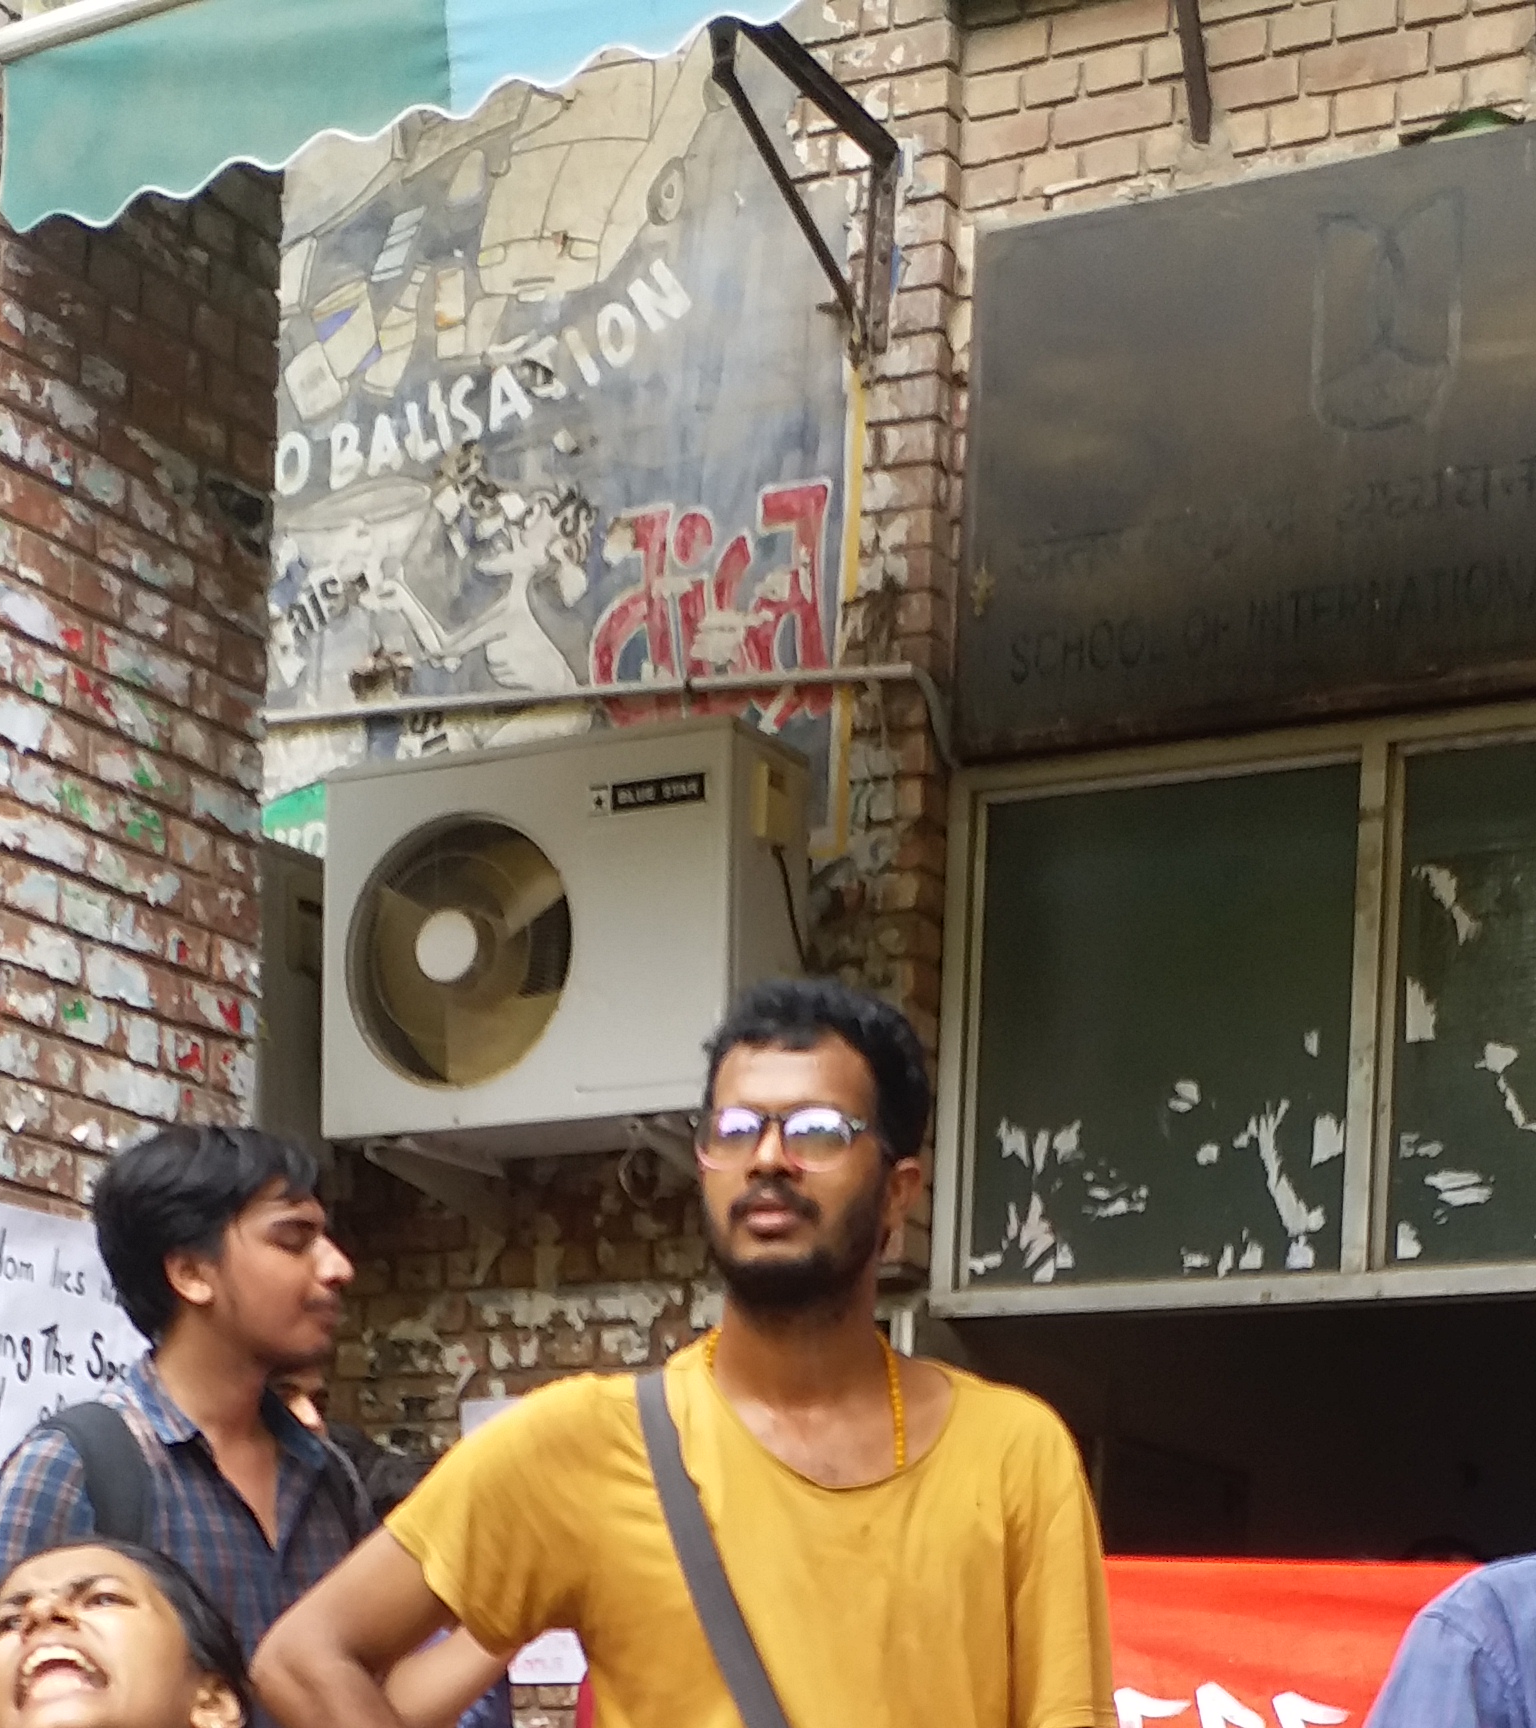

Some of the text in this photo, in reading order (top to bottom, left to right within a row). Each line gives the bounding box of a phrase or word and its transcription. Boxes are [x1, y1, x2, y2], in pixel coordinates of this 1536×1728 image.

[1007, 612, 1164, 686] SCHOOL
[1183, 605, 1232, 657] OF
[616, 781, 700, 804] BLUE STAR
[39, 1323, 76, 1376] The
